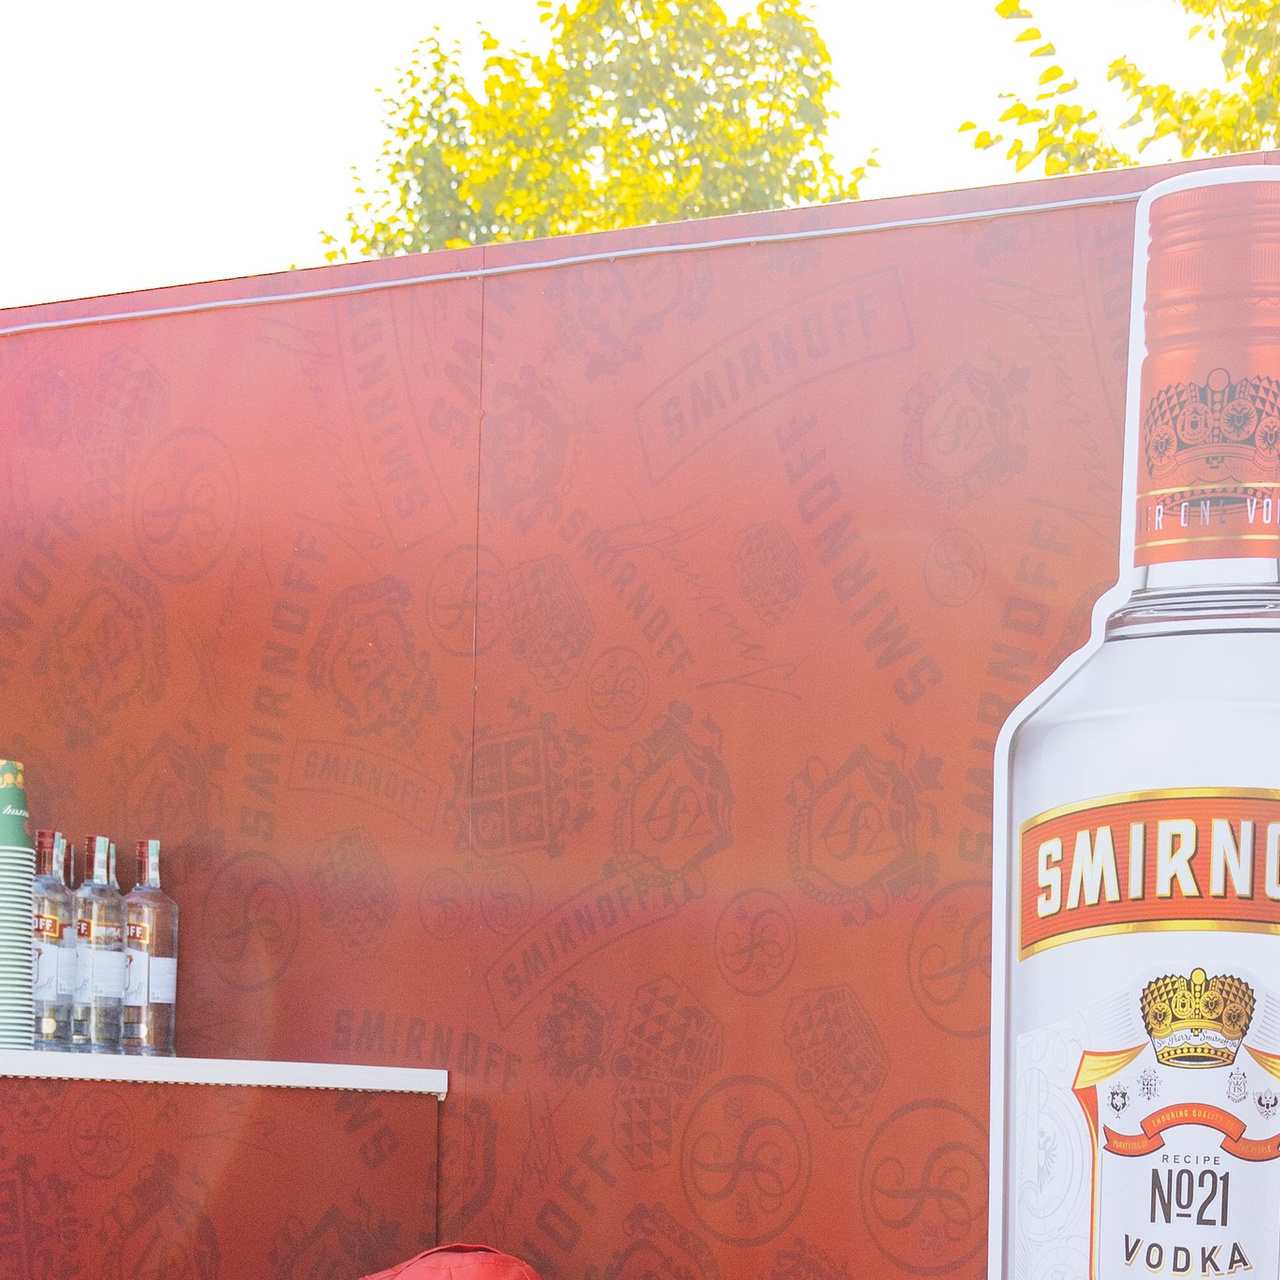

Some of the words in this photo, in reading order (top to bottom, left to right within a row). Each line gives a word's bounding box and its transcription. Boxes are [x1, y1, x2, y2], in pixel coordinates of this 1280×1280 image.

[660, 294, 880, 447] SMIRNOFF
[559, 506, 695, 678] SMIRNOFF
[774, 413, 944, 708] SMIRNOFF
[239, 531, 328, 842] SMIRNOFF
[304, 750, 427, 812] SMIRNOFF
[501, 882, 650, 1001] SMIRNOFF
[331, 1008, 521, 1093] SMIRNOFF
[1162, 1154, 1221, 1165] RECIPE
[1124, 1234, 1253, 1277] VODKA
